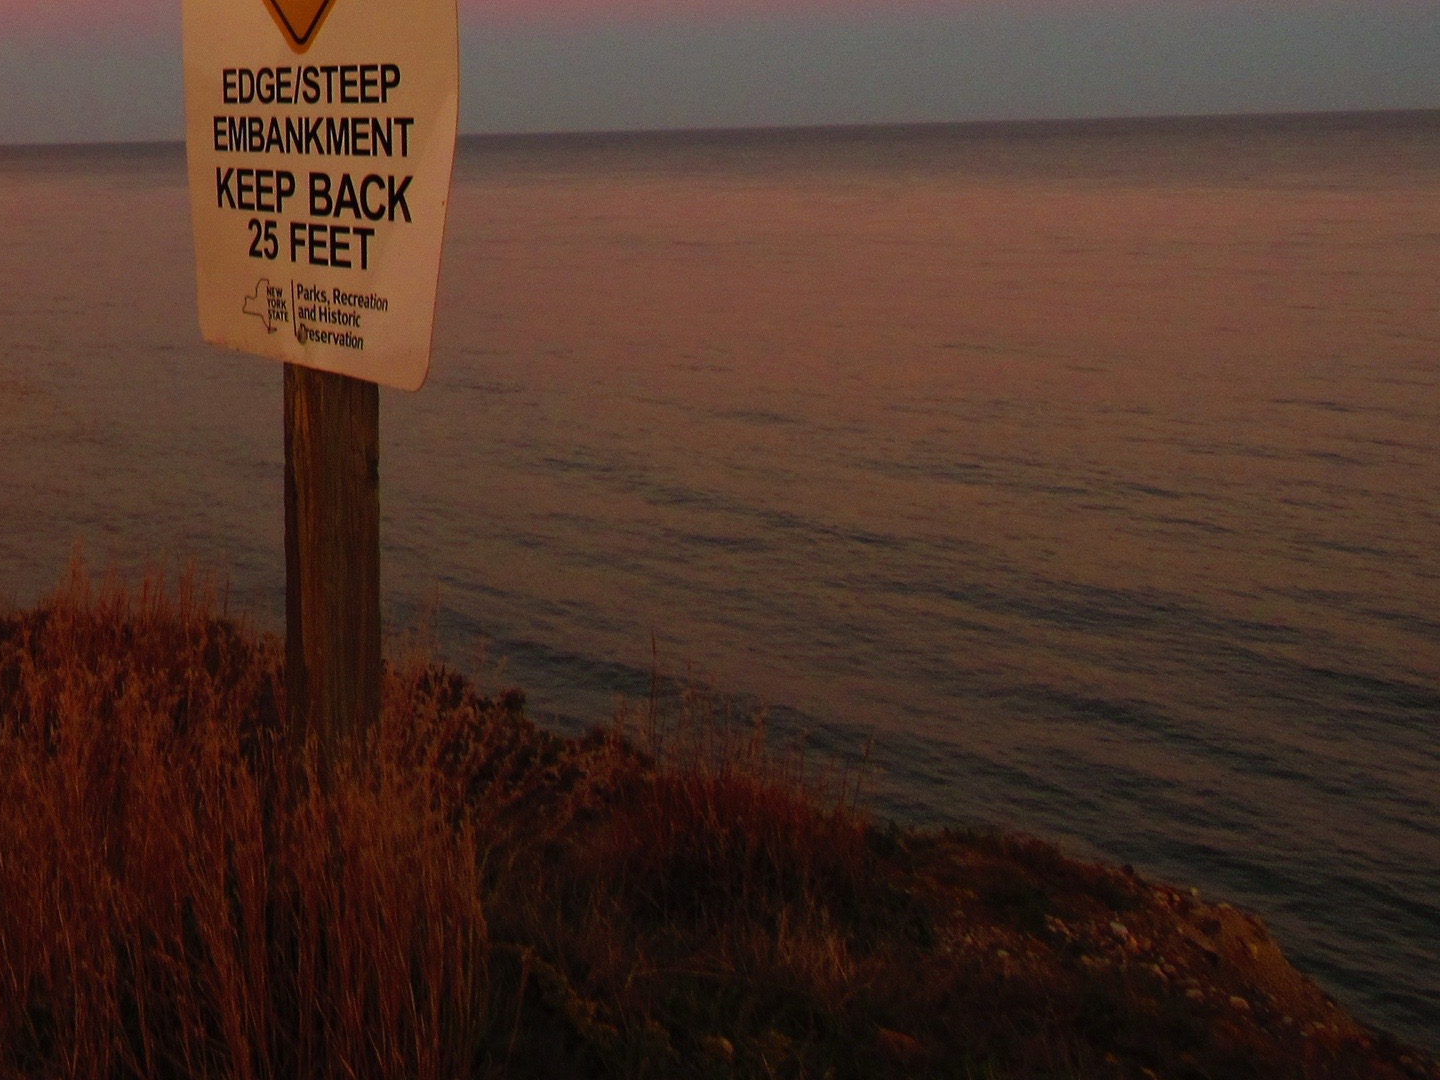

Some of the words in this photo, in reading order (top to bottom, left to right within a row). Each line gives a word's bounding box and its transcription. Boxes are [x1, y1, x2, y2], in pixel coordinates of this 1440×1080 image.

[222, 64, 401, 105] EDGE/STEEP
[213, 116, 415, 157] EMBANKMENT
[216, 167, 296, 213] KEEP
[309, 172, 413, 223] BACK
[248, 218, 279, 260] 25
[289, 222, 375, 270] FEET
[266, 286, 283, 298] NEW
[266, 298, 287, 310] YORK
[296, 283, 330, 305] Parks,
[333, 288, 389, 312] Recreation
[267, 310, 289, 322] STATE
[298, 304, 316, 321] and
[318, 306, 362, 328] Historic
